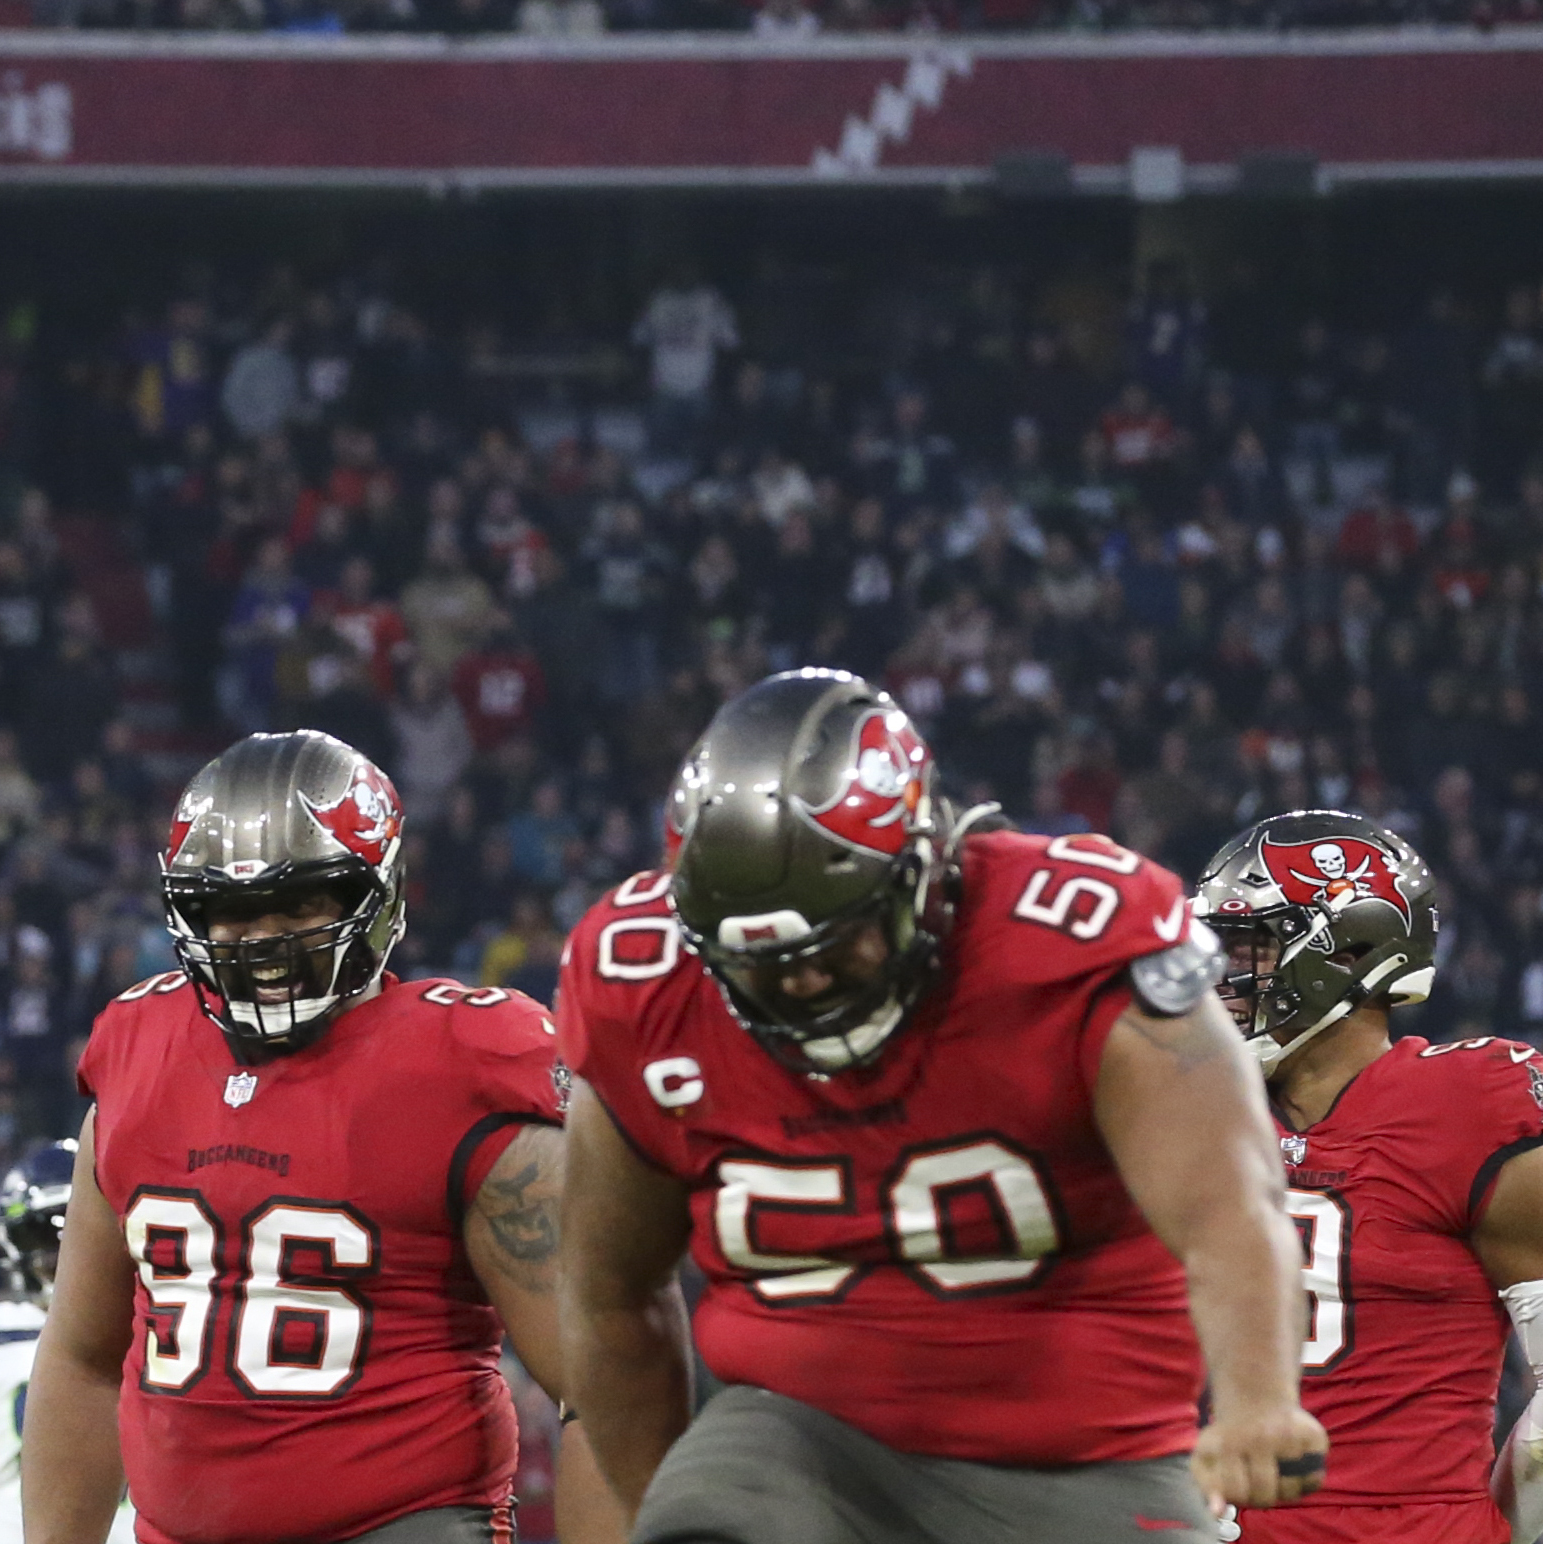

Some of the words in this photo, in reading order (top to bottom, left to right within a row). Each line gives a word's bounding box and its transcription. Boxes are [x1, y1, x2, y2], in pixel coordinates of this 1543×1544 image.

[643, 1056, 704, 1108] C
[188, 1145, 291, 1176] BUCCANEERS
[715, 1137, 1057, 1302] 50
[125, 1186, 381, 1400] 96
